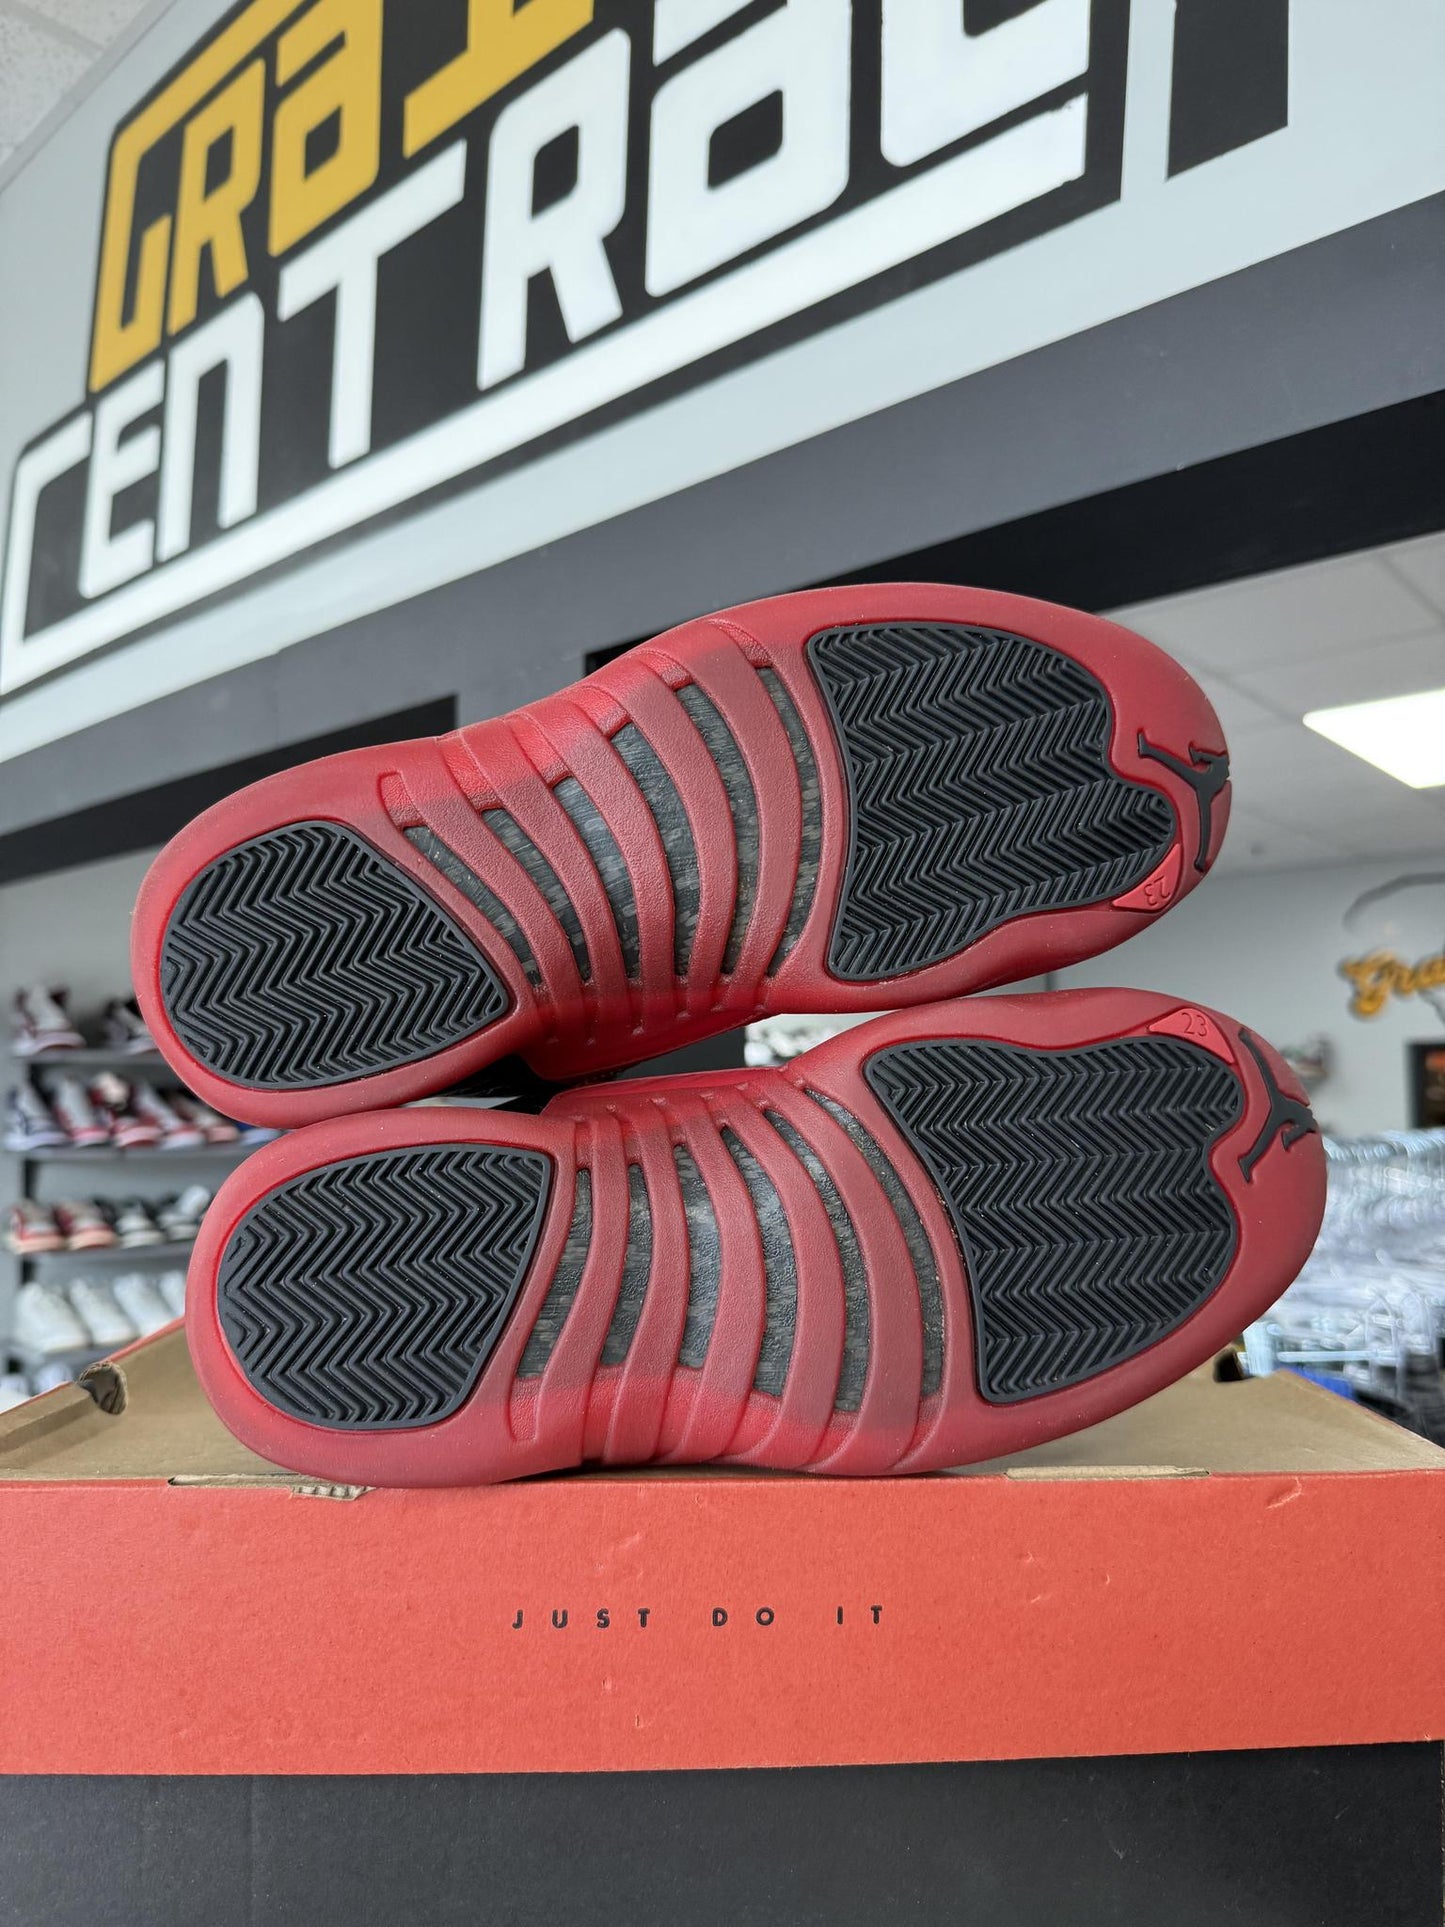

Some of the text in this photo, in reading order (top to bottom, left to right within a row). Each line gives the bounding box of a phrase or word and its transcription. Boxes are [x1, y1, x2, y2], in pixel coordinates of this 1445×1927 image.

[1144, 875, 1171, 906] 23
[1181, 1012, 1208, 1037] 23
[511, 1604, 883, 1629] JUST DO IT
